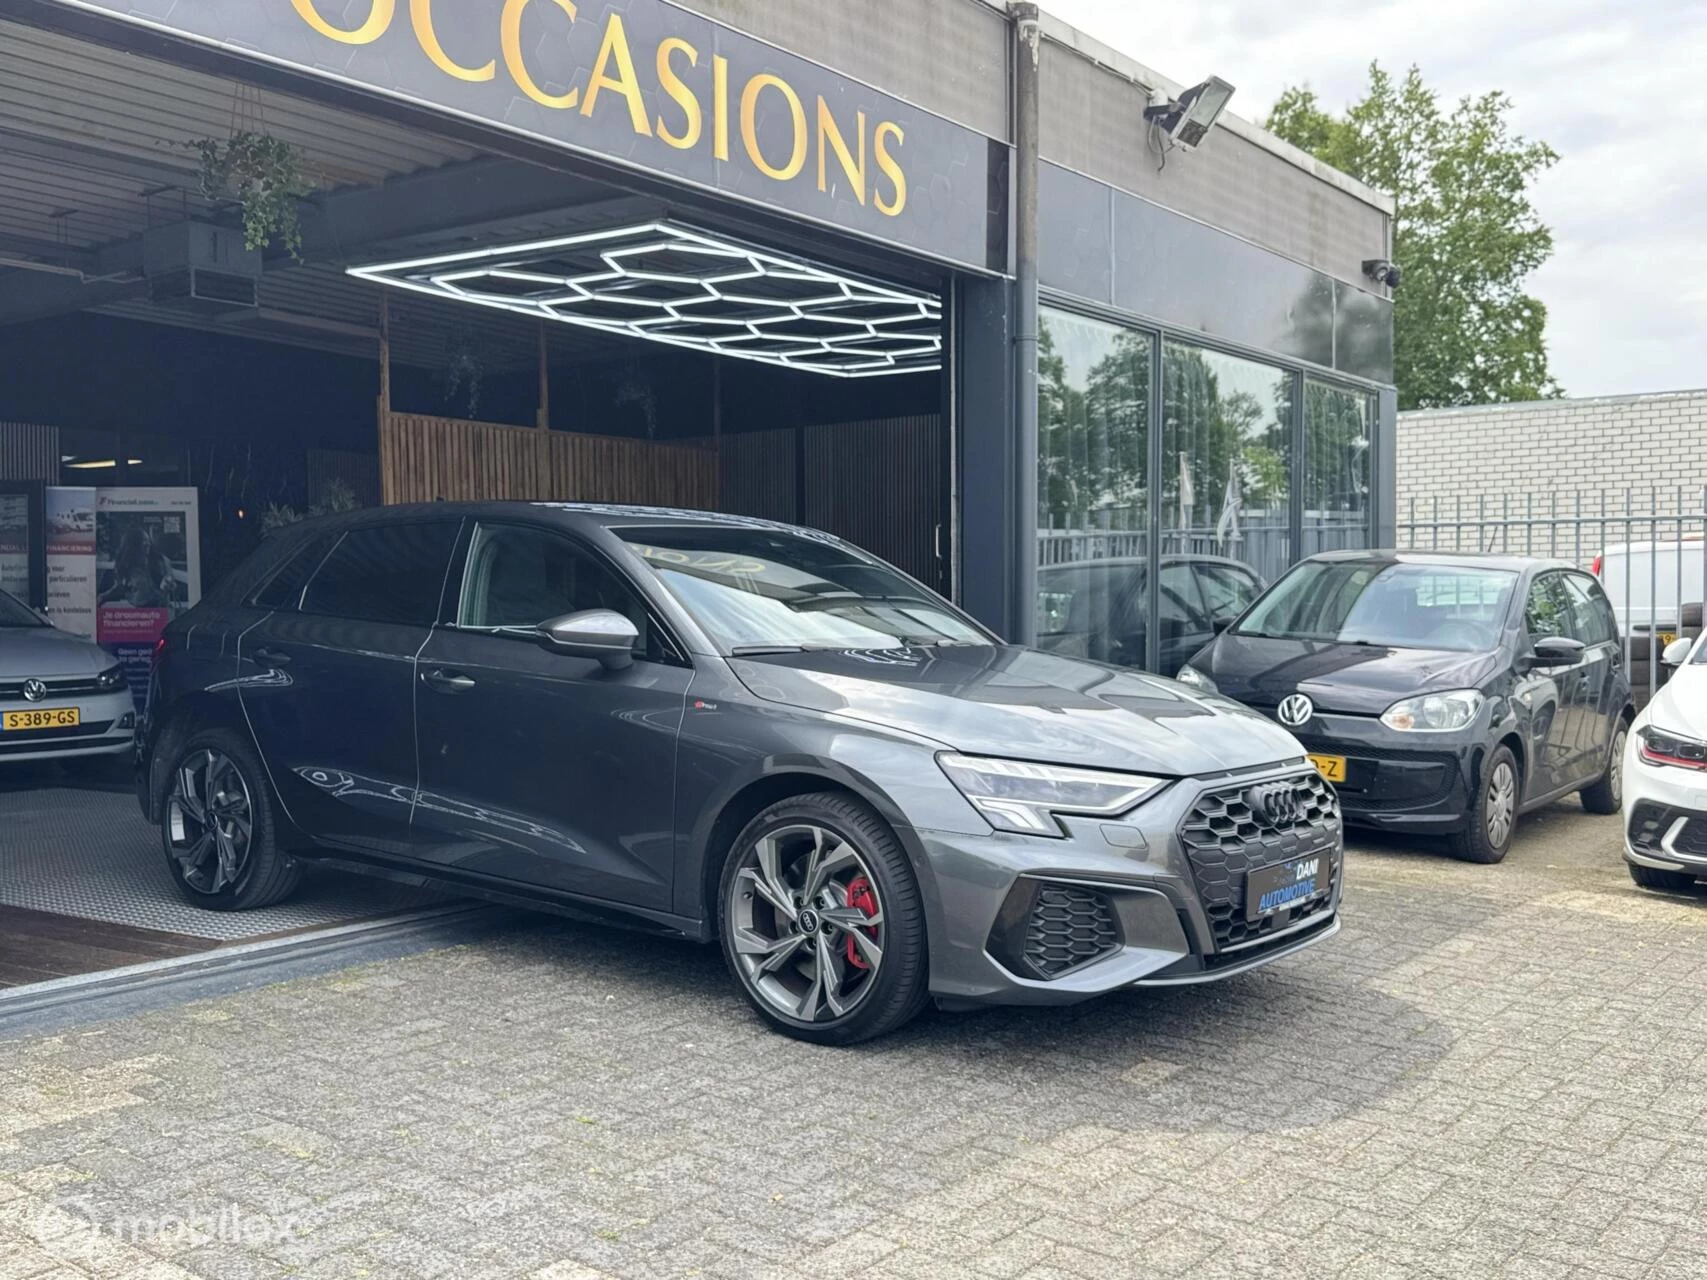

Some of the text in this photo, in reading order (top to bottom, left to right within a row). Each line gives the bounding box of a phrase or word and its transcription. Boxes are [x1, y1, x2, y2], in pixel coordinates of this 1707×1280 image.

[9, 710, 75, 728] S-389-GS
[1296, 858, 1320, 881] DANI
[1258, 879, 1316, 910] AUTOMOTIVE
